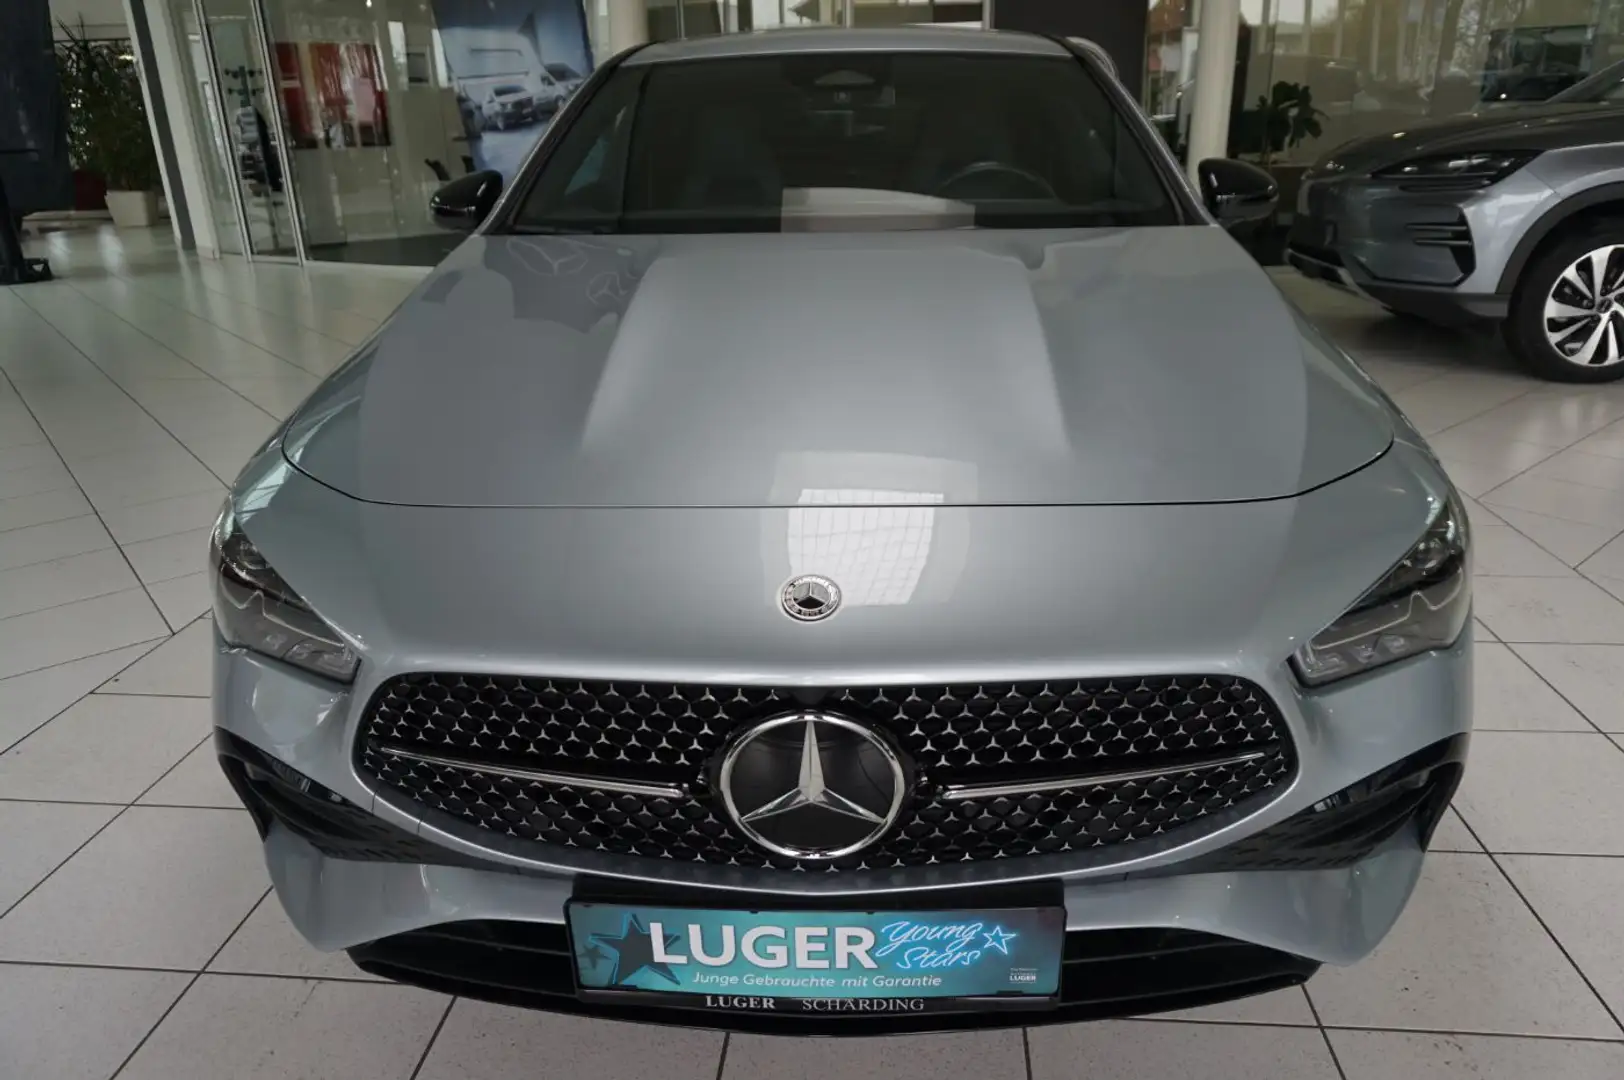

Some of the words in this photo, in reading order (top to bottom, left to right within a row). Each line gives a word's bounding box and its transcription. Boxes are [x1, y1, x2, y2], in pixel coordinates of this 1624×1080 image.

[649, 922, 878, 969] LUGER
[875, 921, 983, 957] Young
[896, 946, 981, 969] Stars
[692, 972, 739, 987] Junge
[743, 974, 835, 988] Gebrauchte
[841, 975, 868, 987] mit
[872, 974, 942, 987] Garantie
[705, 995, 776, 1009] LUGER
